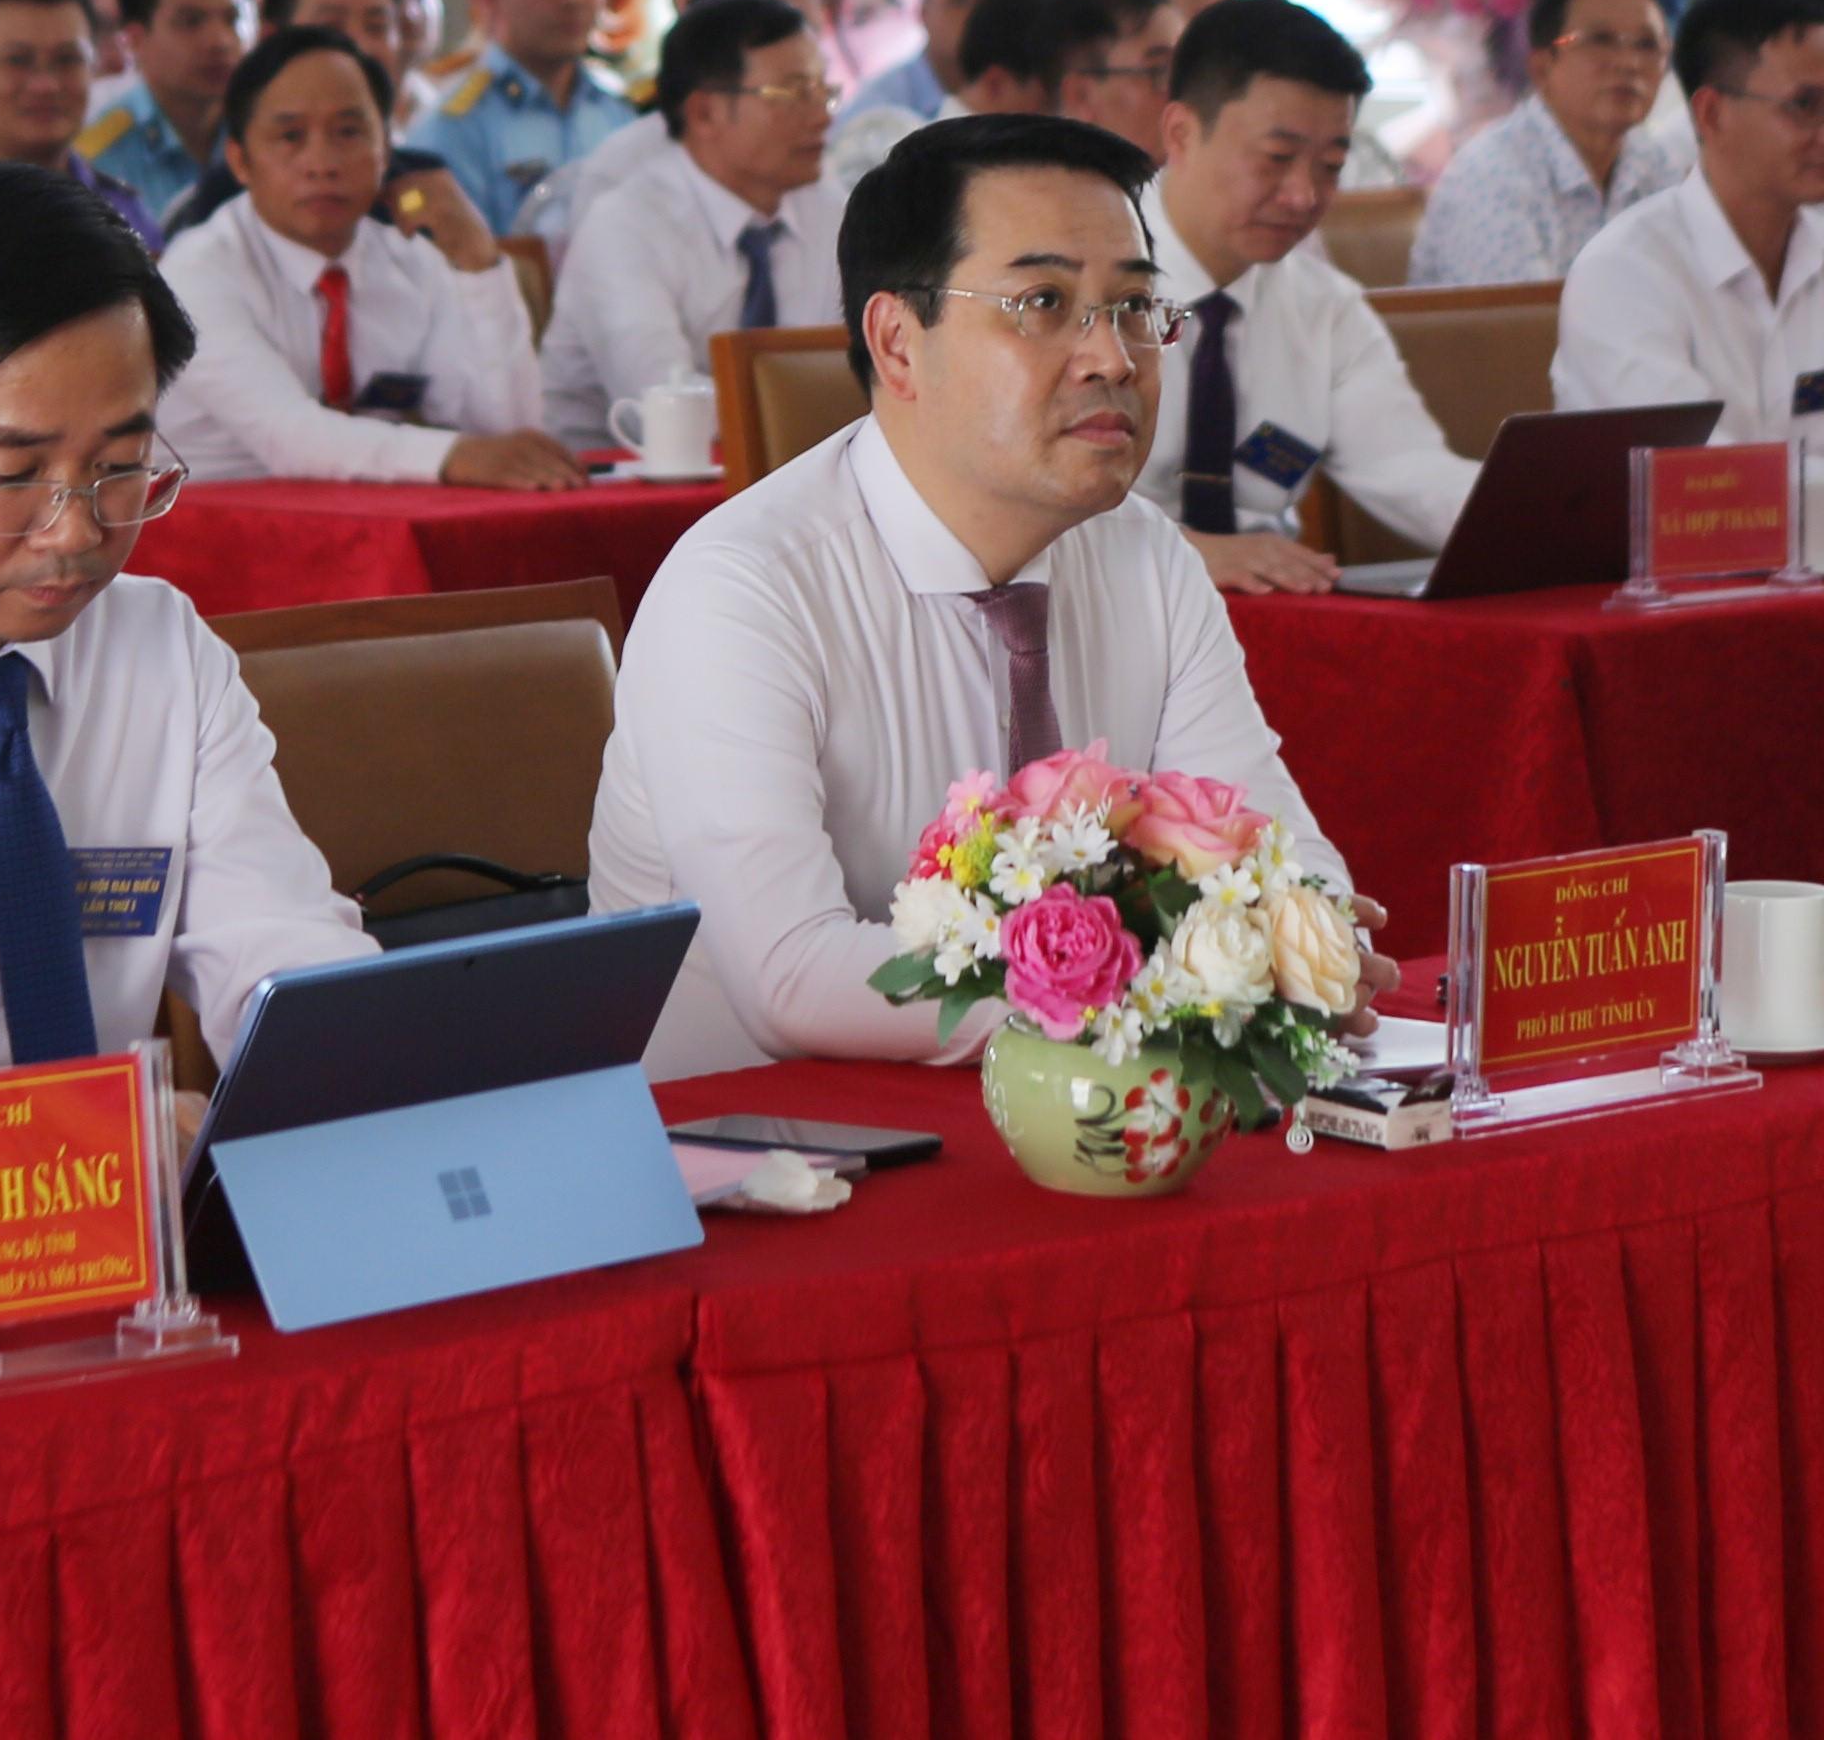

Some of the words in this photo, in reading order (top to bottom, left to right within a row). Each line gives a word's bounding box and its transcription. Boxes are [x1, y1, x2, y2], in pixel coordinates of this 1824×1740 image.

[1555, 877, 1598, 903] ĐỒNG
[1601, 876, 1630, 898] CHÍ
[1493, 915, 1580, 992] NGUYỄN
[1584, 907, 1640, 977] TUẤN
[1642, 919, 1688, 968] ANH
[32, 1142, 123, 1217] SÁNG
